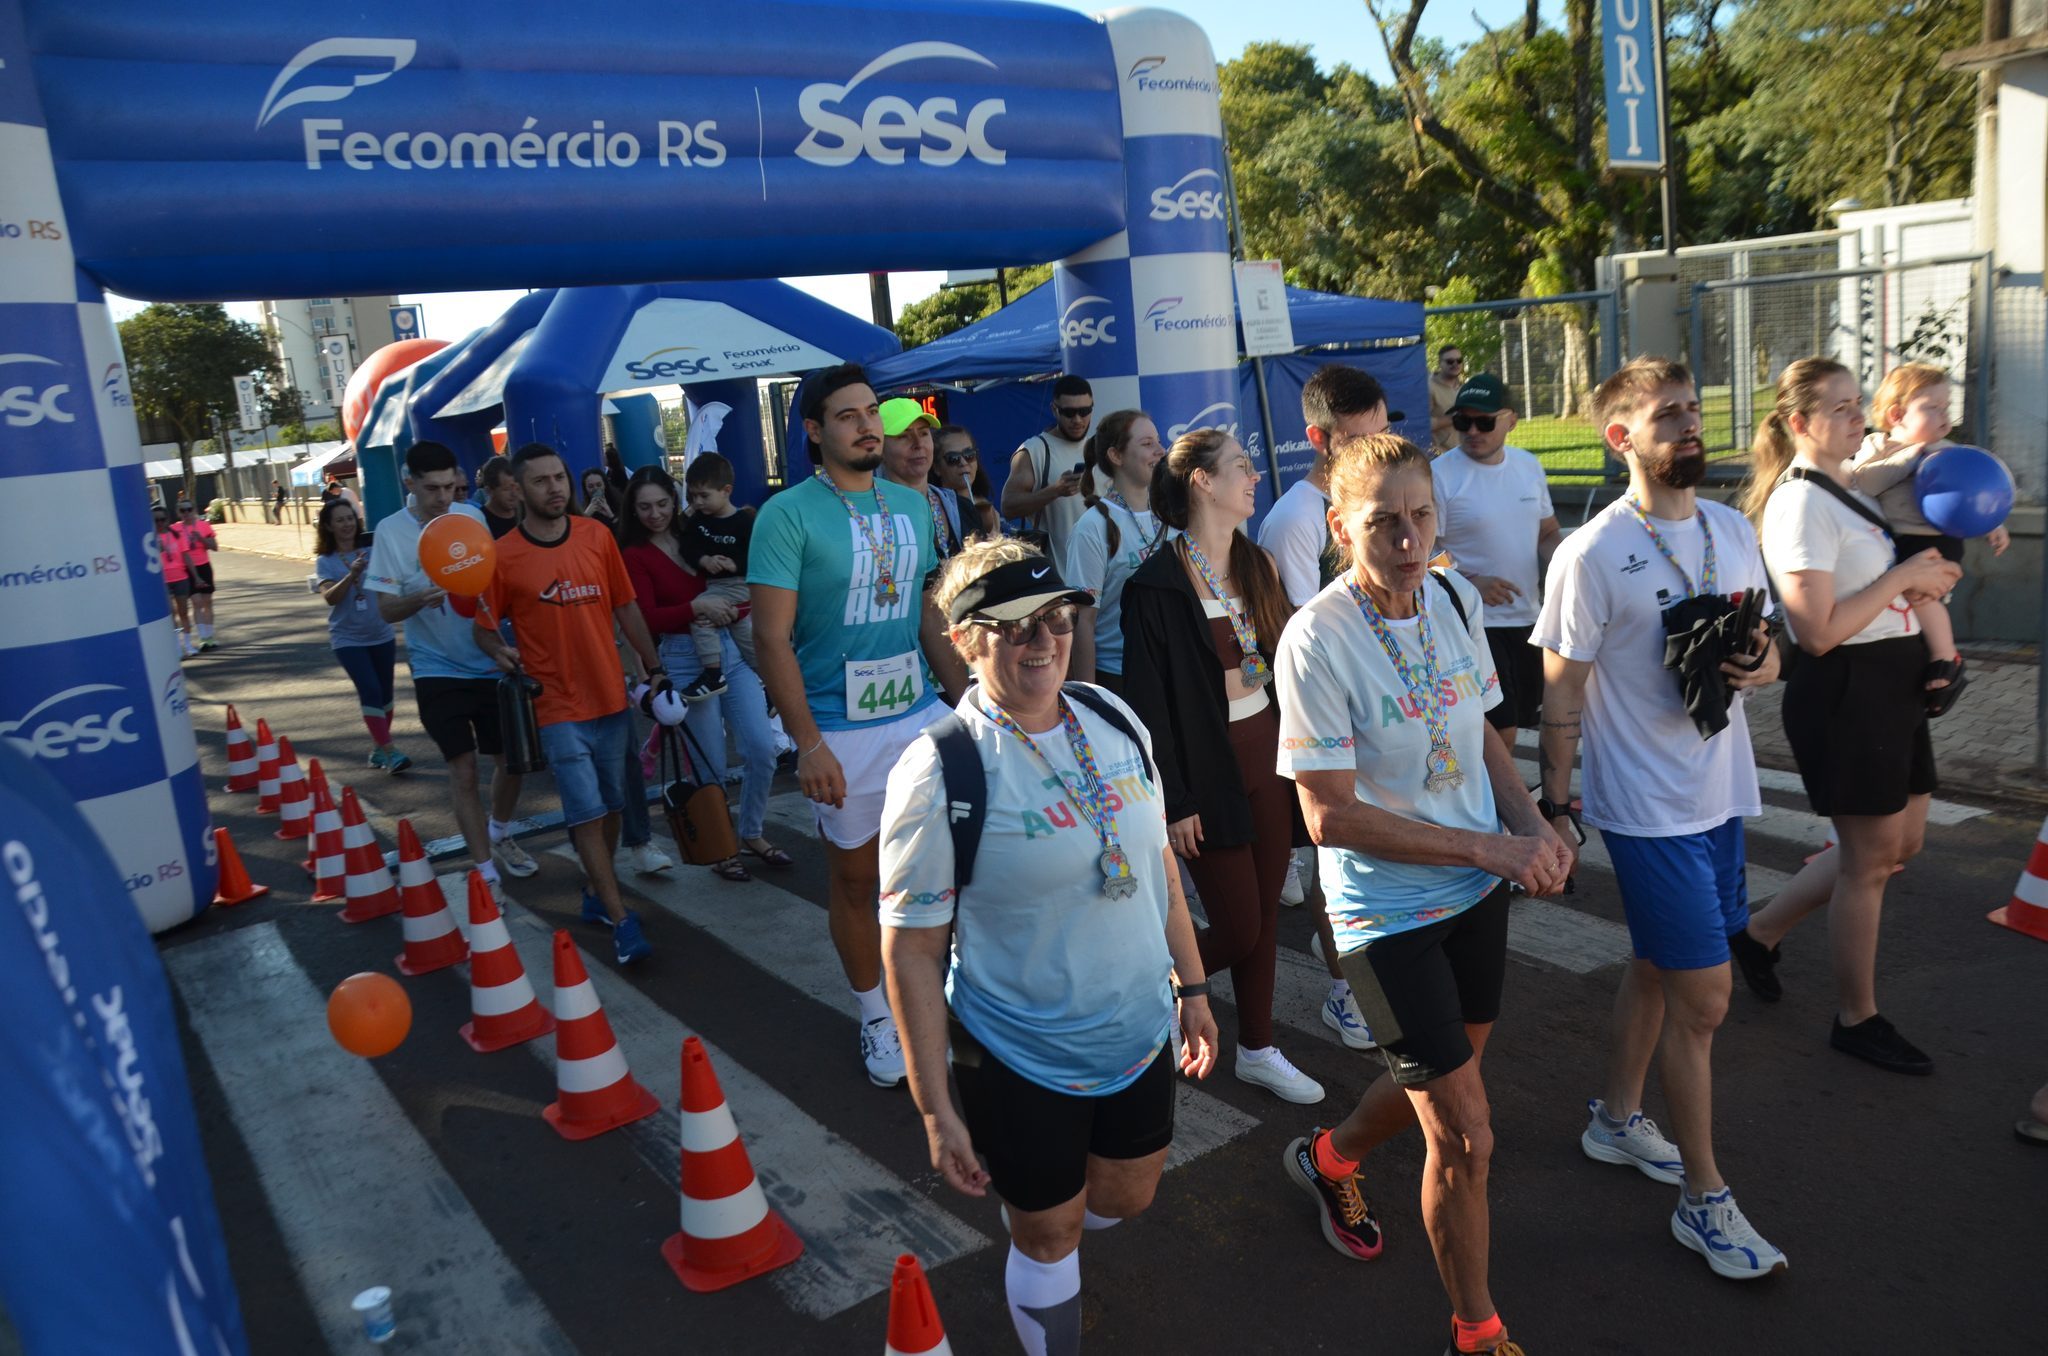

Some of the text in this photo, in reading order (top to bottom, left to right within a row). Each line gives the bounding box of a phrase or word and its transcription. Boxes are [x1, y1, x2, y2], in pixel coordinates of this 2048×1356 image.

[302, 116, 641, 171] Fecomércio
[657, 120, 728, 169] RS
[28, 219, 62, 241] RS
[722, 342, 801, 360] Fecomércio
[0, 554, 122, 587] mércio RS
[440, 553, 485, 576] CRESOL
[857, 674, 916, 714] 444
[156, 859, 184, 883] RS
[1298, 1151, 1319, 1181] CORRE
